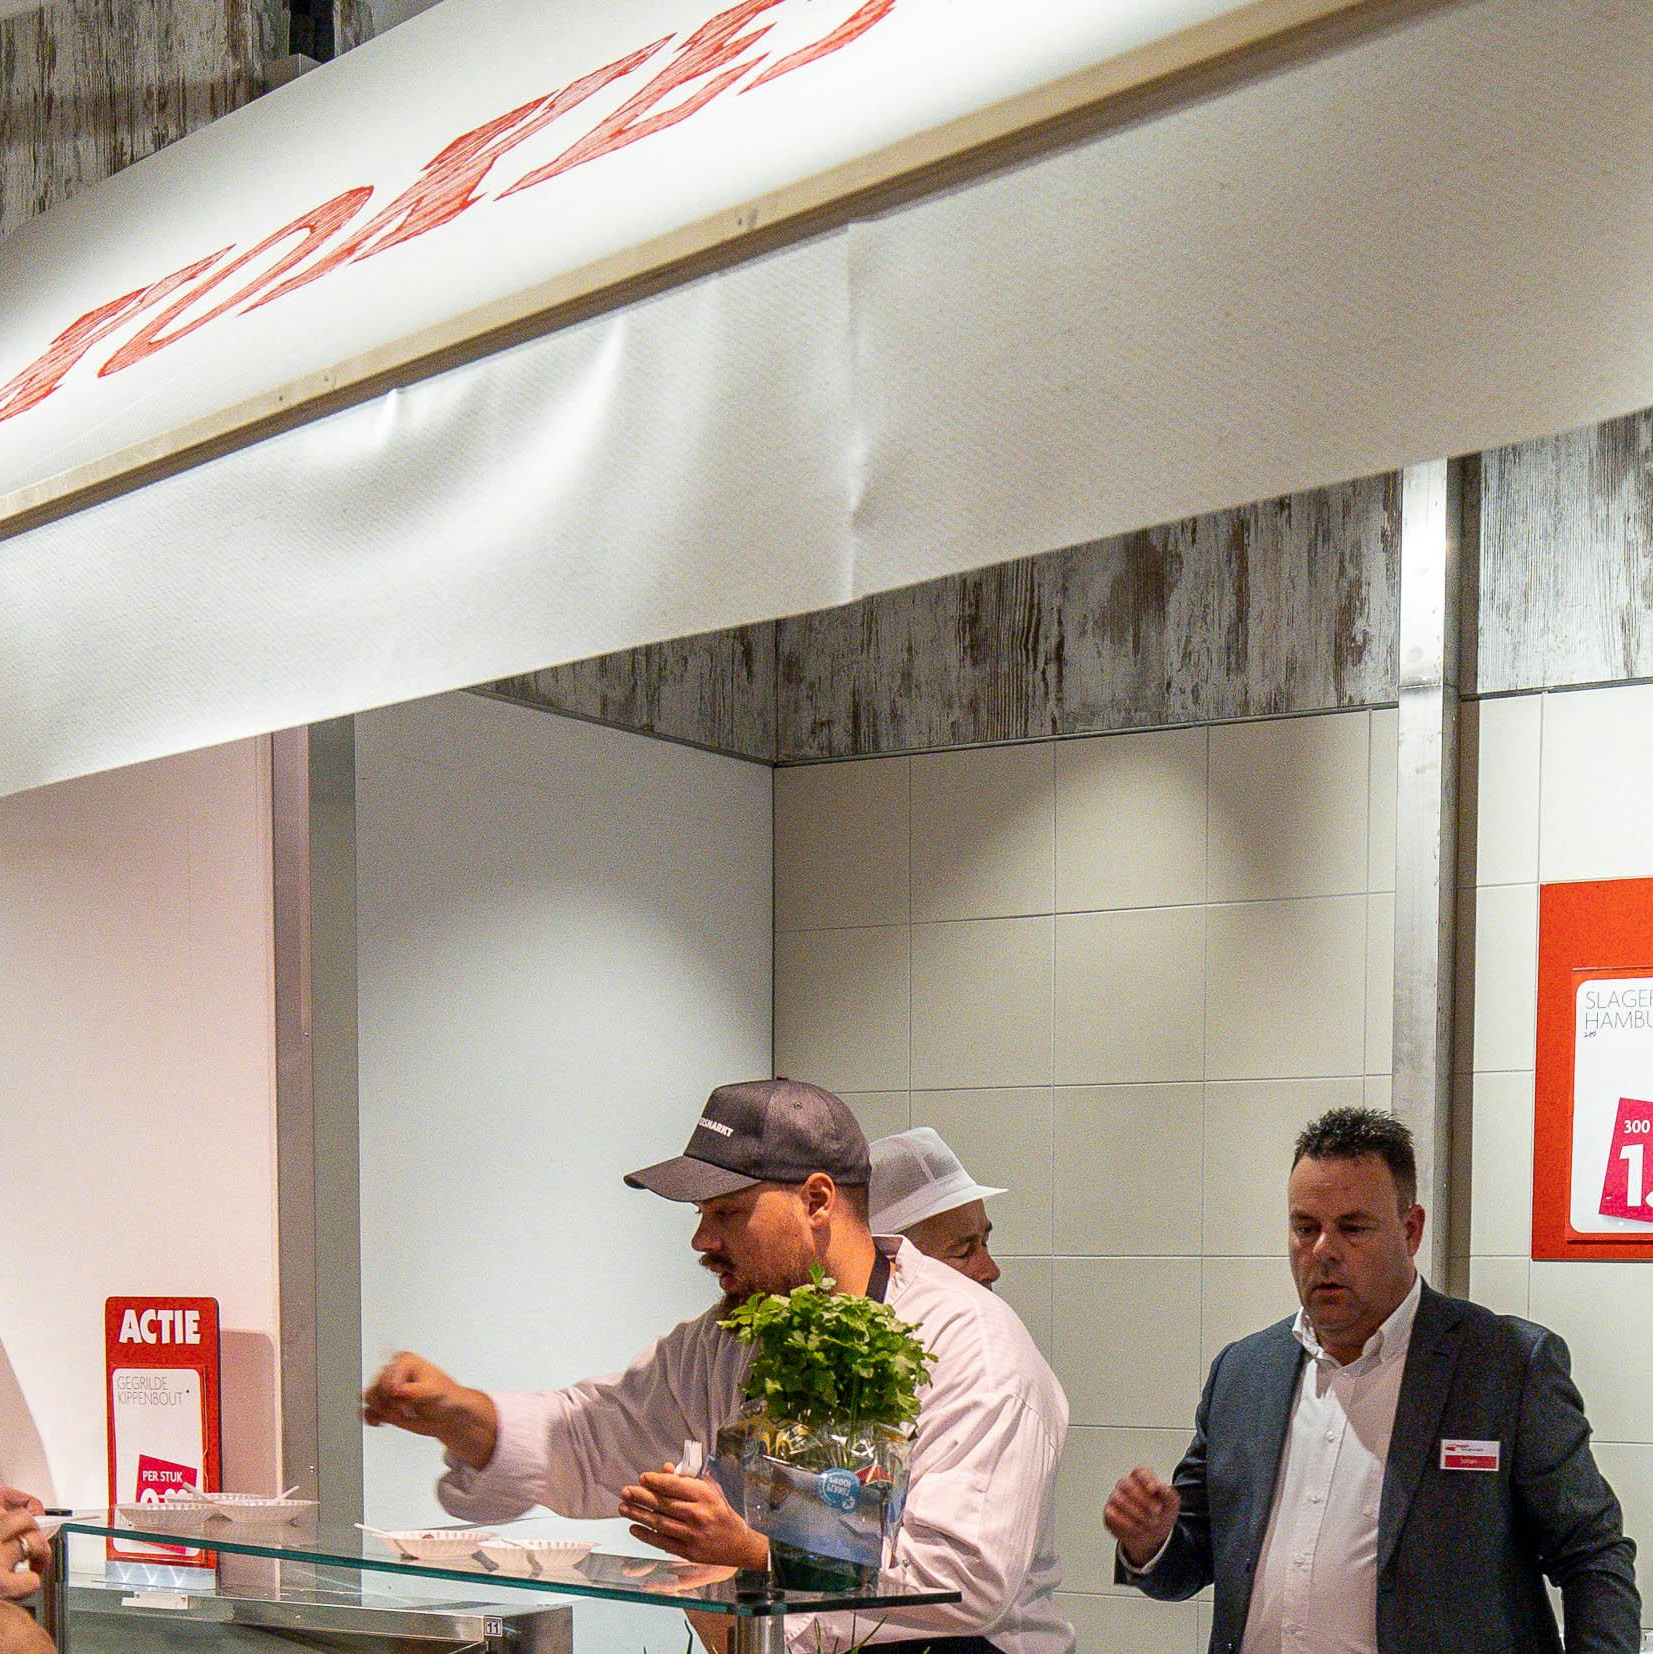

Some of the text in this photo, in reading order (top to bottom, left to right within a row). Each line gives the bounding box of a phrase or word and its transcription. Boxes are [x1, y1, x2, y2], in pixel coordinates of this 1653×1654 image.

[1623, 1119, 1650, 1135] 300
[118, 1308, 201, 1345] ACTIE
[116, 1375, 169, 1391] GEGRILDE
[117, 1391, 183, 1406] KIPPENBOUT
[142, 1470, 184, 1484] PER STUK
